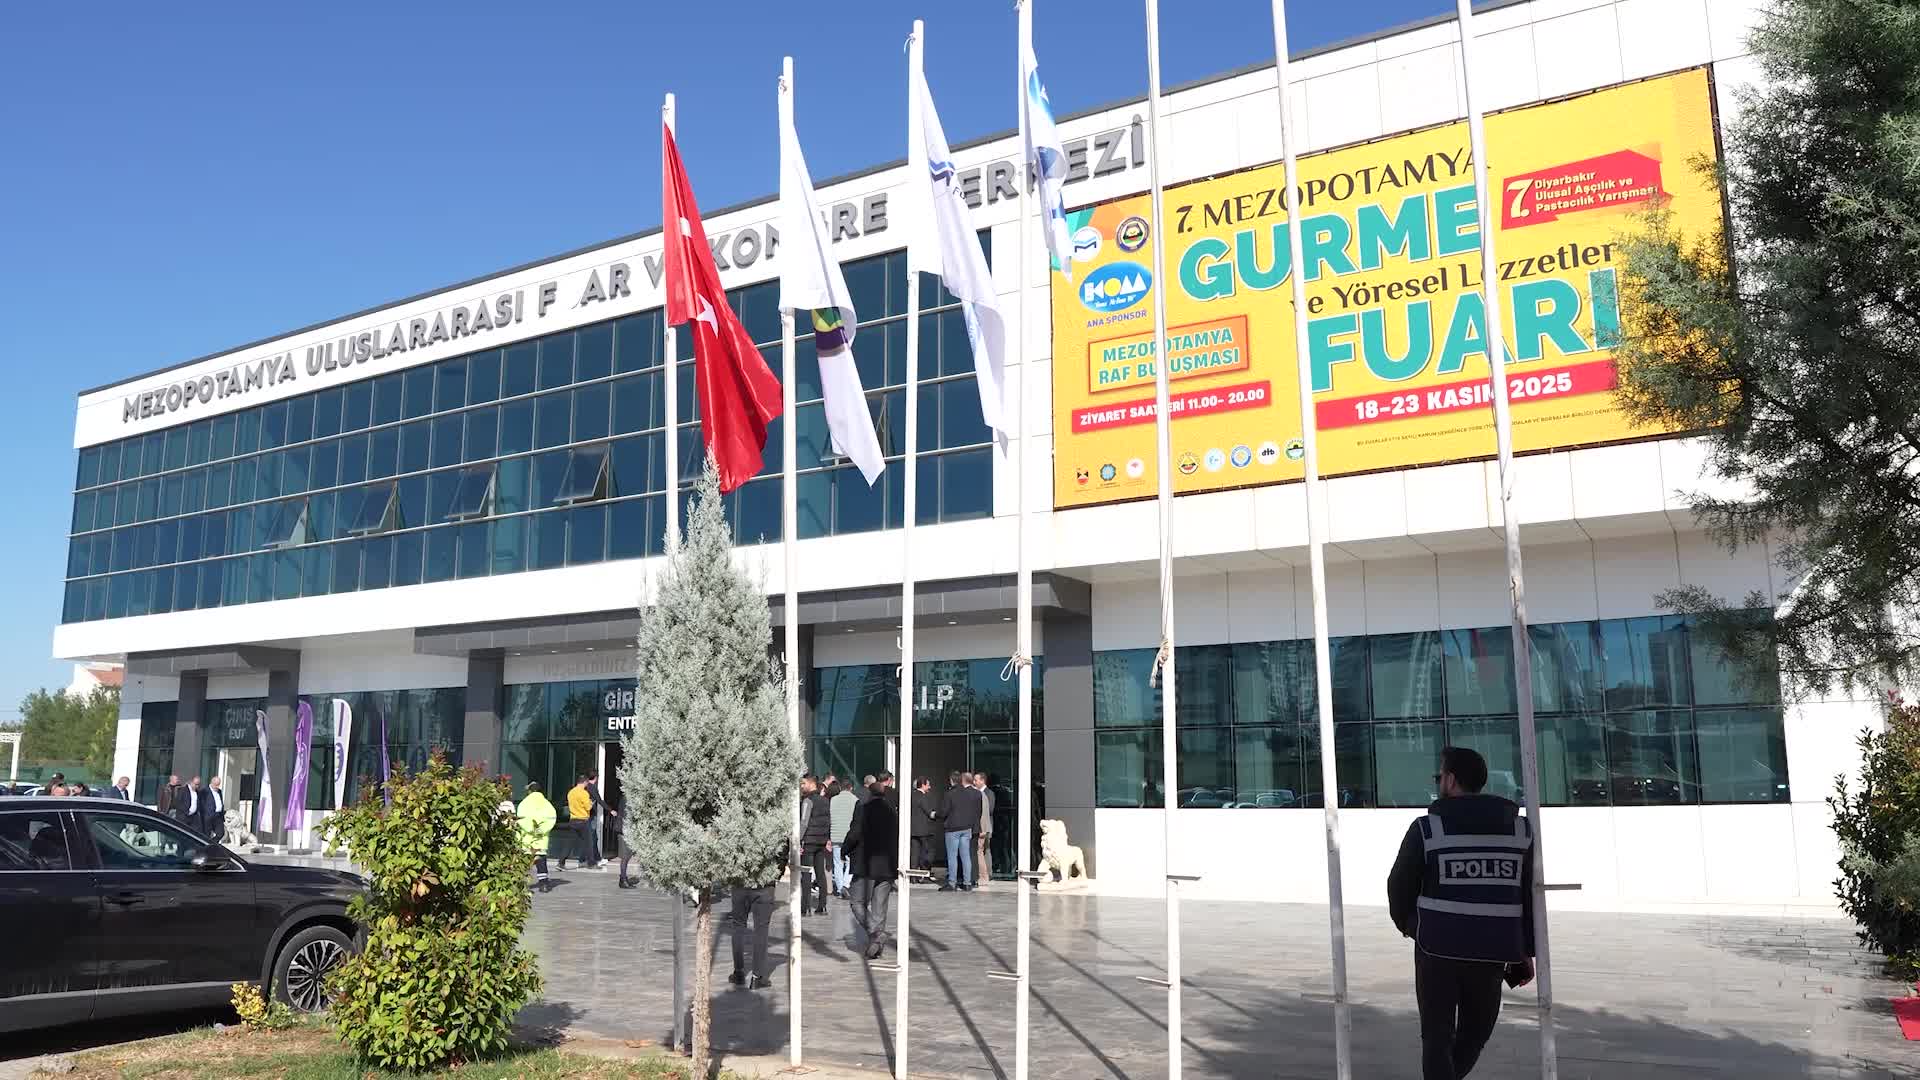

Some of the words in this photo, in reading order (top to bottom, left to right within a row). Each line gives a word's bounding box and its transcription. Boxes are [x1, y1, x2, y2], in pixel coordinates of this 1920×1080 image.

[1506, 178, 1534, 219] 7.
[1534, 171, 1596, 190] Diyarbakır
[1535, 188, 1572, 201] Ulusal
[1574, 179, 1616, 195] Aşçılık
[1618, 176, 1633, 187] ve
[1175, 204, 1194, 234] 7.
[1535, 197, 1595, 213] Pastacılık
[1178, 183, 1483, 301] GURME
[1332, 267, 1449, 309] Yöresel
[1457, 242, 1618, 288] Lzzetler
[1087, 318, 1105, 328] ANA
[1105, 309, 1148, 324] SPONSOR
[1307, 268, 1622, 394] FUARI
[121, 351, 296, 423] MEZOPOTAMYA
[305, 290, 525, 376] ULUSLARARASI
[1098, 366, 1131, 385] RAF
[1137, 348, 1240, 378] BUUŞMASI
[1080, 409, 1127, 426] ZİYARET
[1129, 399, 1185, 419] SAATERİ
[1227, 388, 1265, 404] 20.00
[1354, 394, 1421, 420] 18-23
[1509, 372, 1573, 399] 2025
[604, 687, 635, 711] GİR
